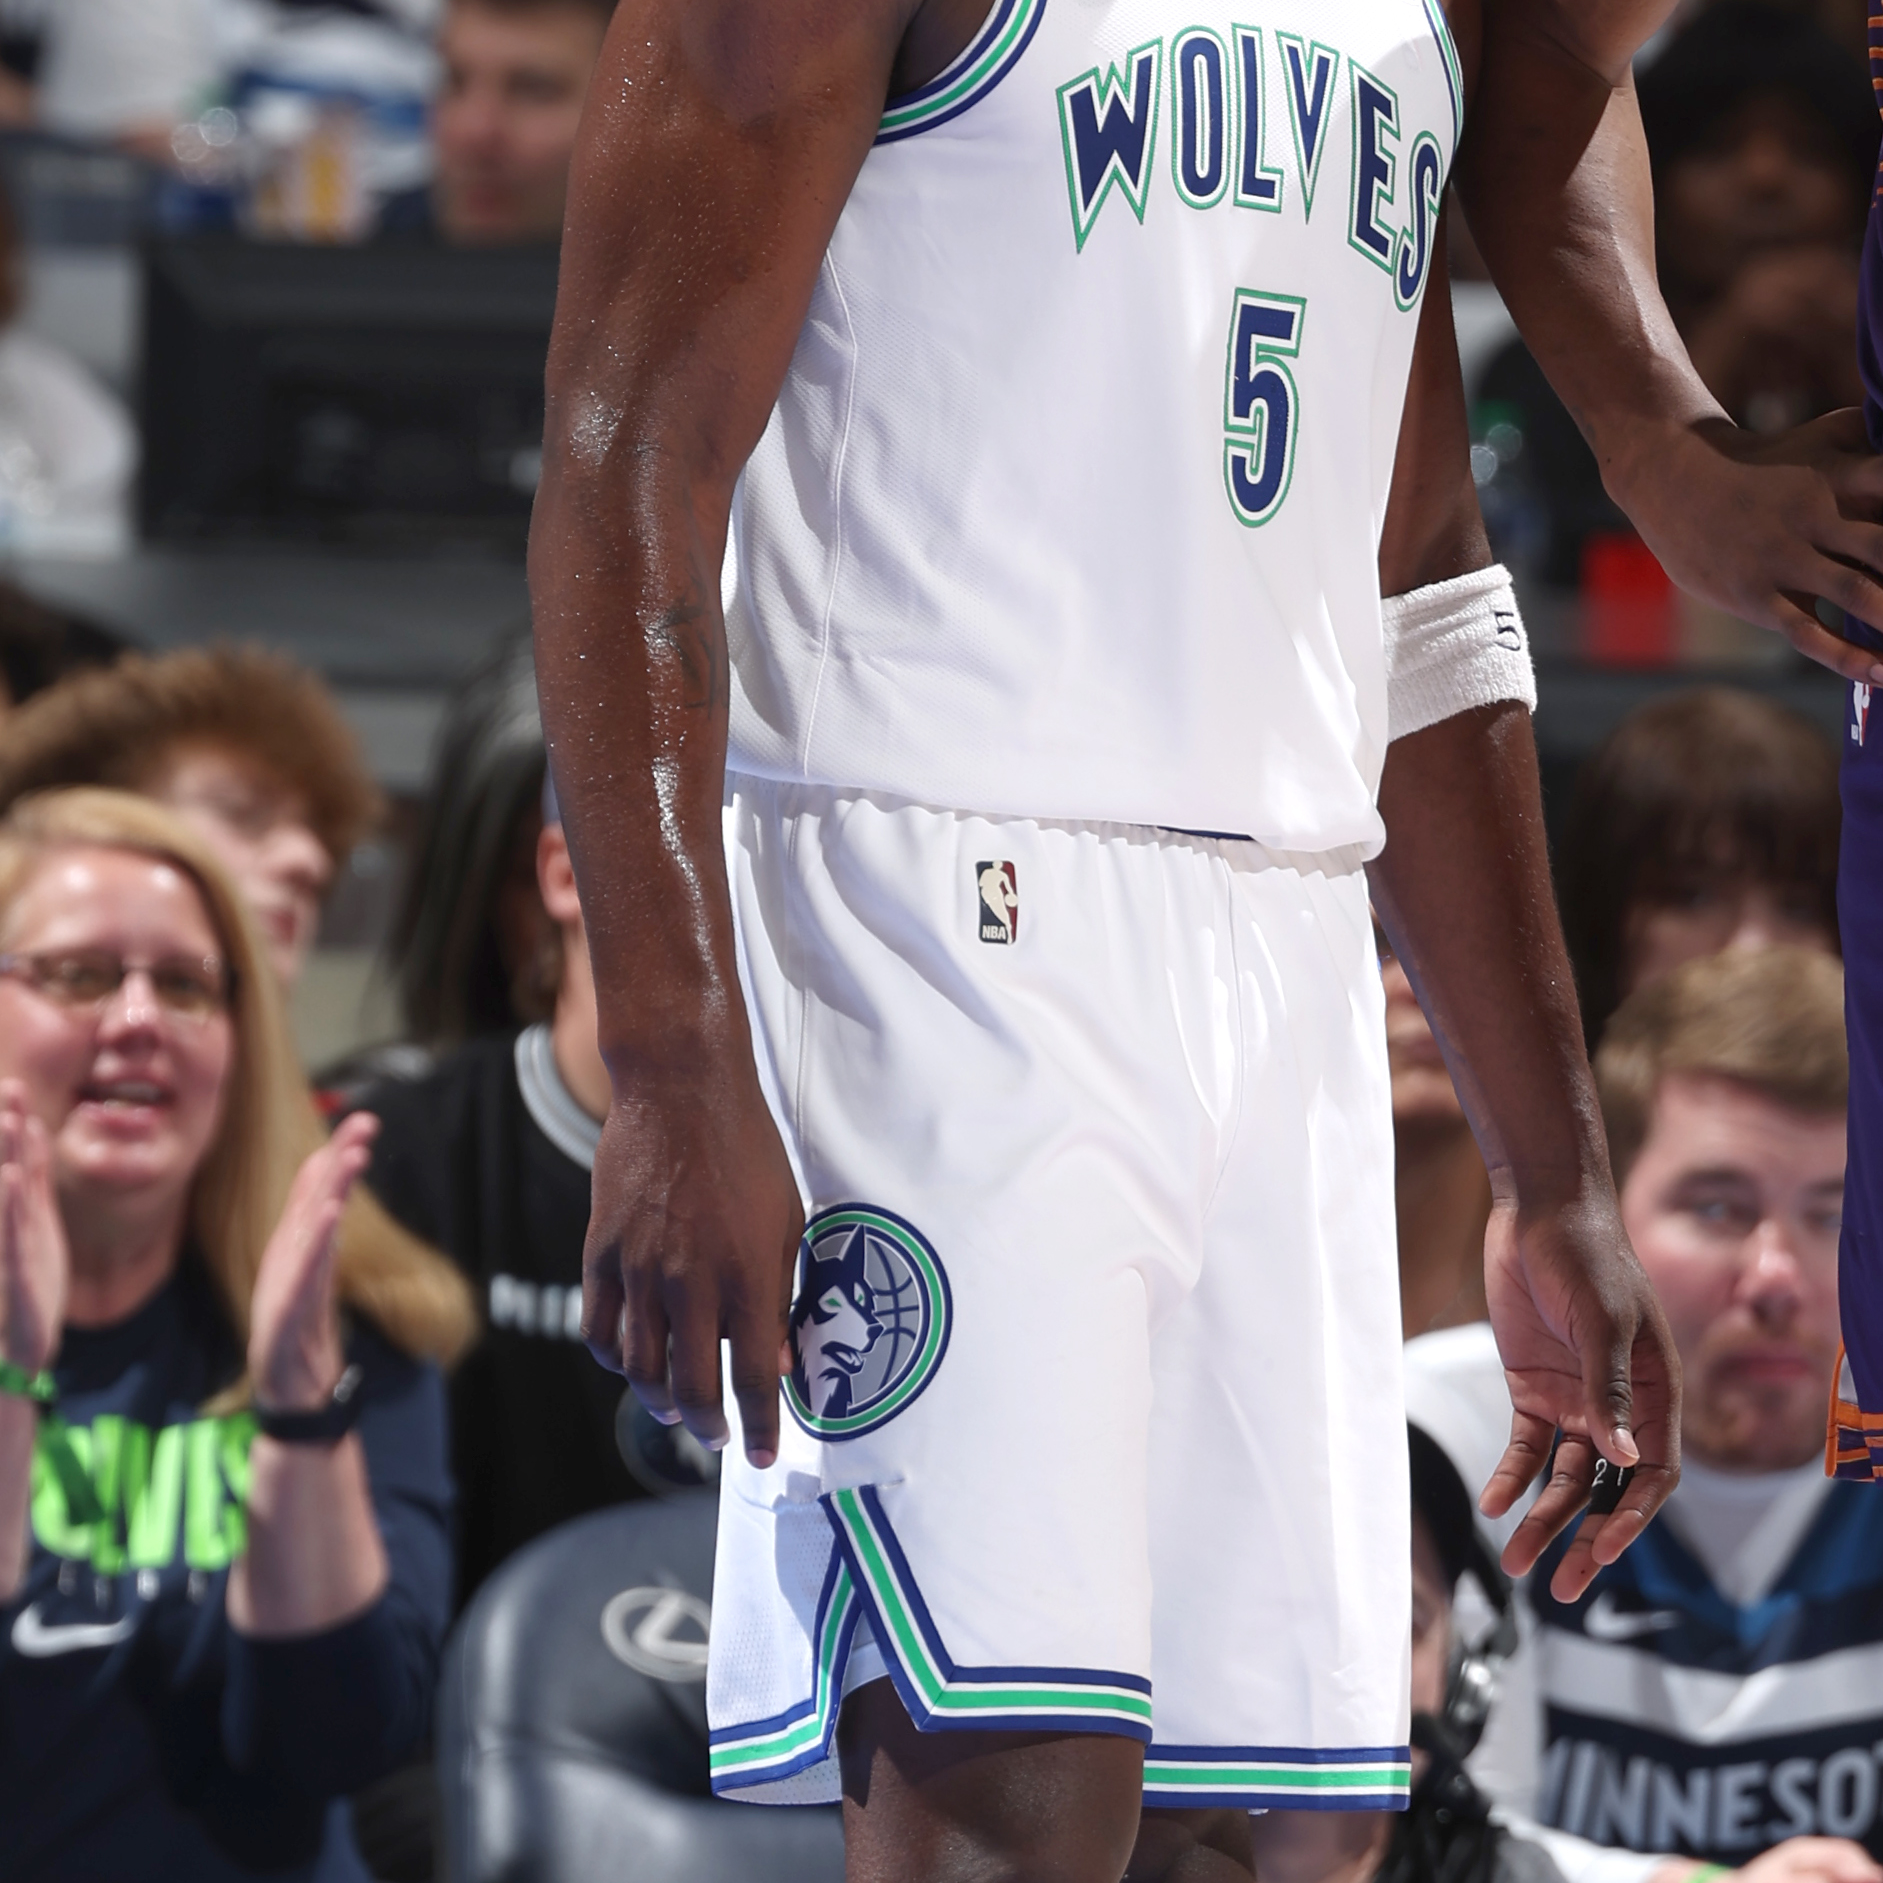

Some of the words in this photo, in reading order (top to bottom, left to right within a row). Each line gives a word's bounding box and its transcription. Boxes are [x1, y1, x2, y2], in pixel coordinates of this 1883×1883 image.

[1055, 22, 1440, 312] WOLVES
[1223, 287, 1307, 528] 5
[1494, 611, 1521, 652] 5
[981, 924, 1007, 940] NBA
